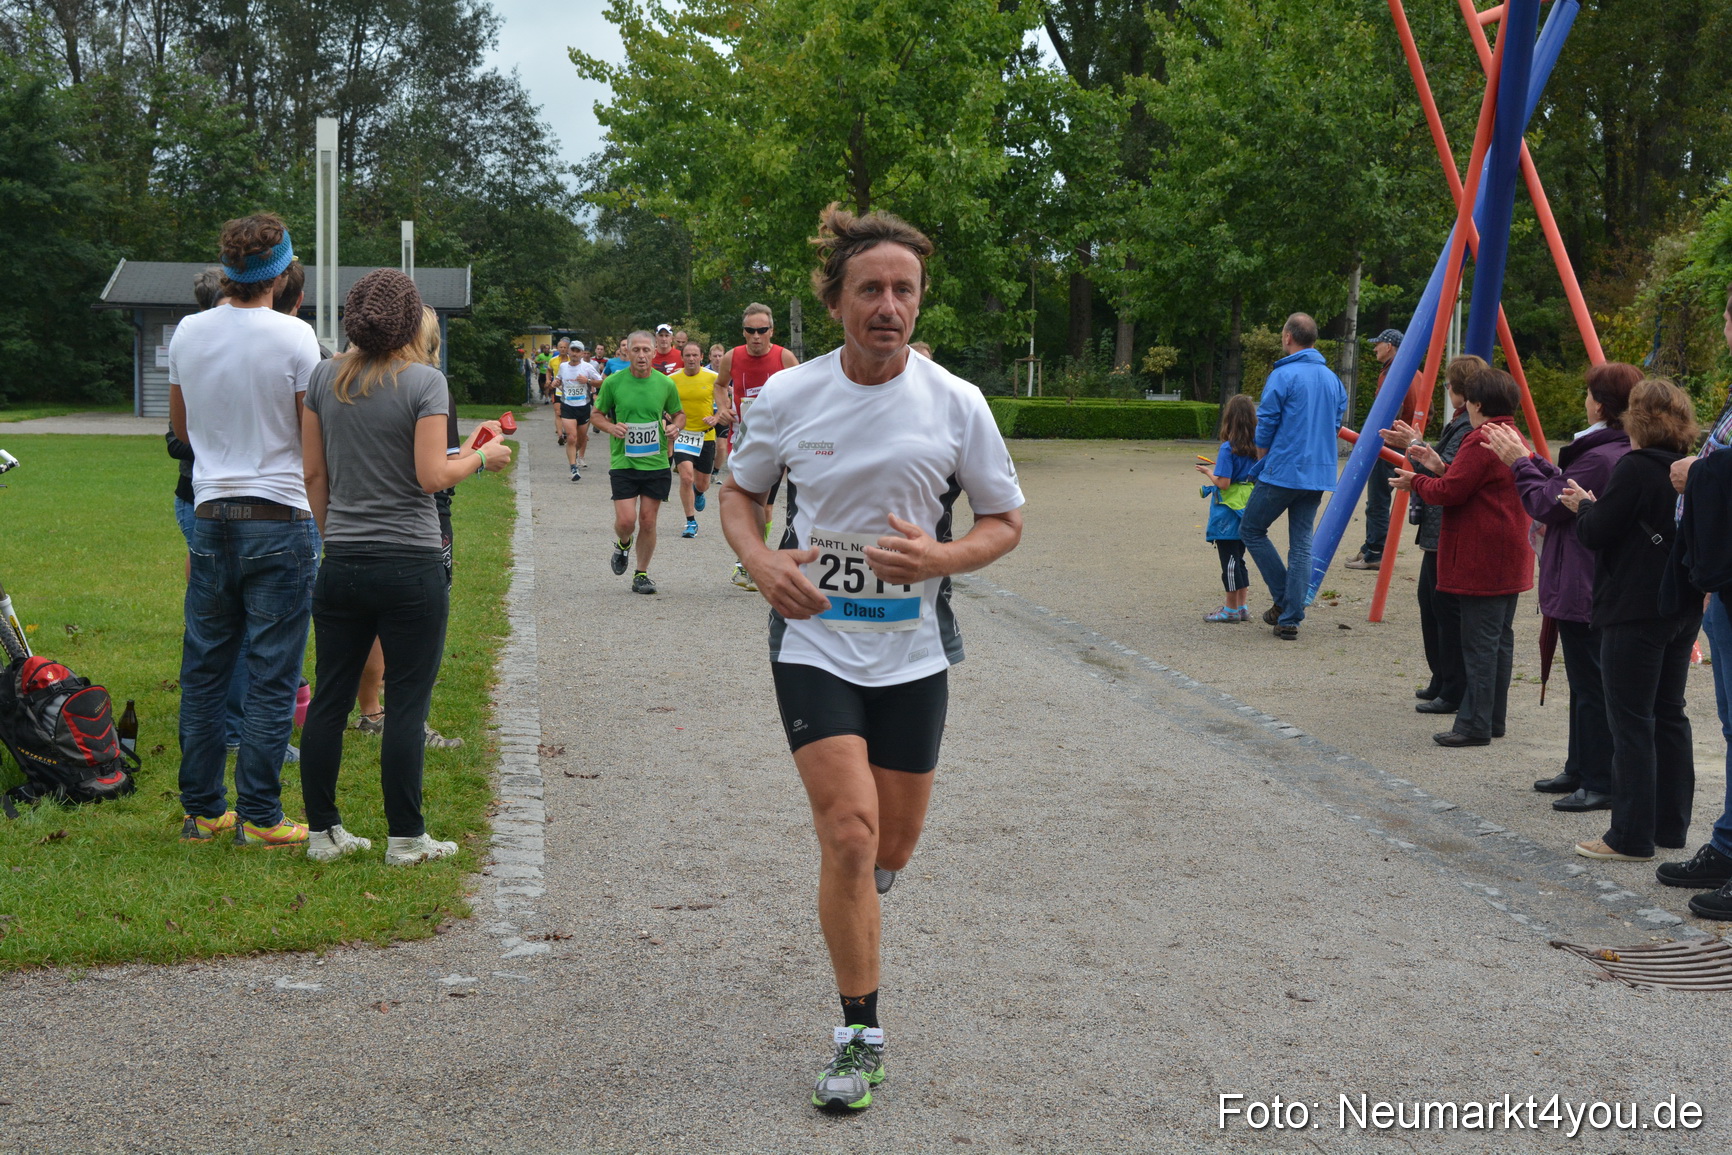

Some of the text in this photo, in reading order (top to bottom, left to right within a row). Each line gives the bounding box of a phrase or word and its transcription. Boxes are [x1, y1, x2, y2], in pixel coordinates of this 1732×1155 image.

[628, 430, 656, 444] 3302
[677, 434, 701, 446] 3311
[212, 505, 252, 519] PMA
[810, 537, 848, 551] PARTL
[819, 553, 911, 594] 25
[843, 602, 886, 618] Claus
